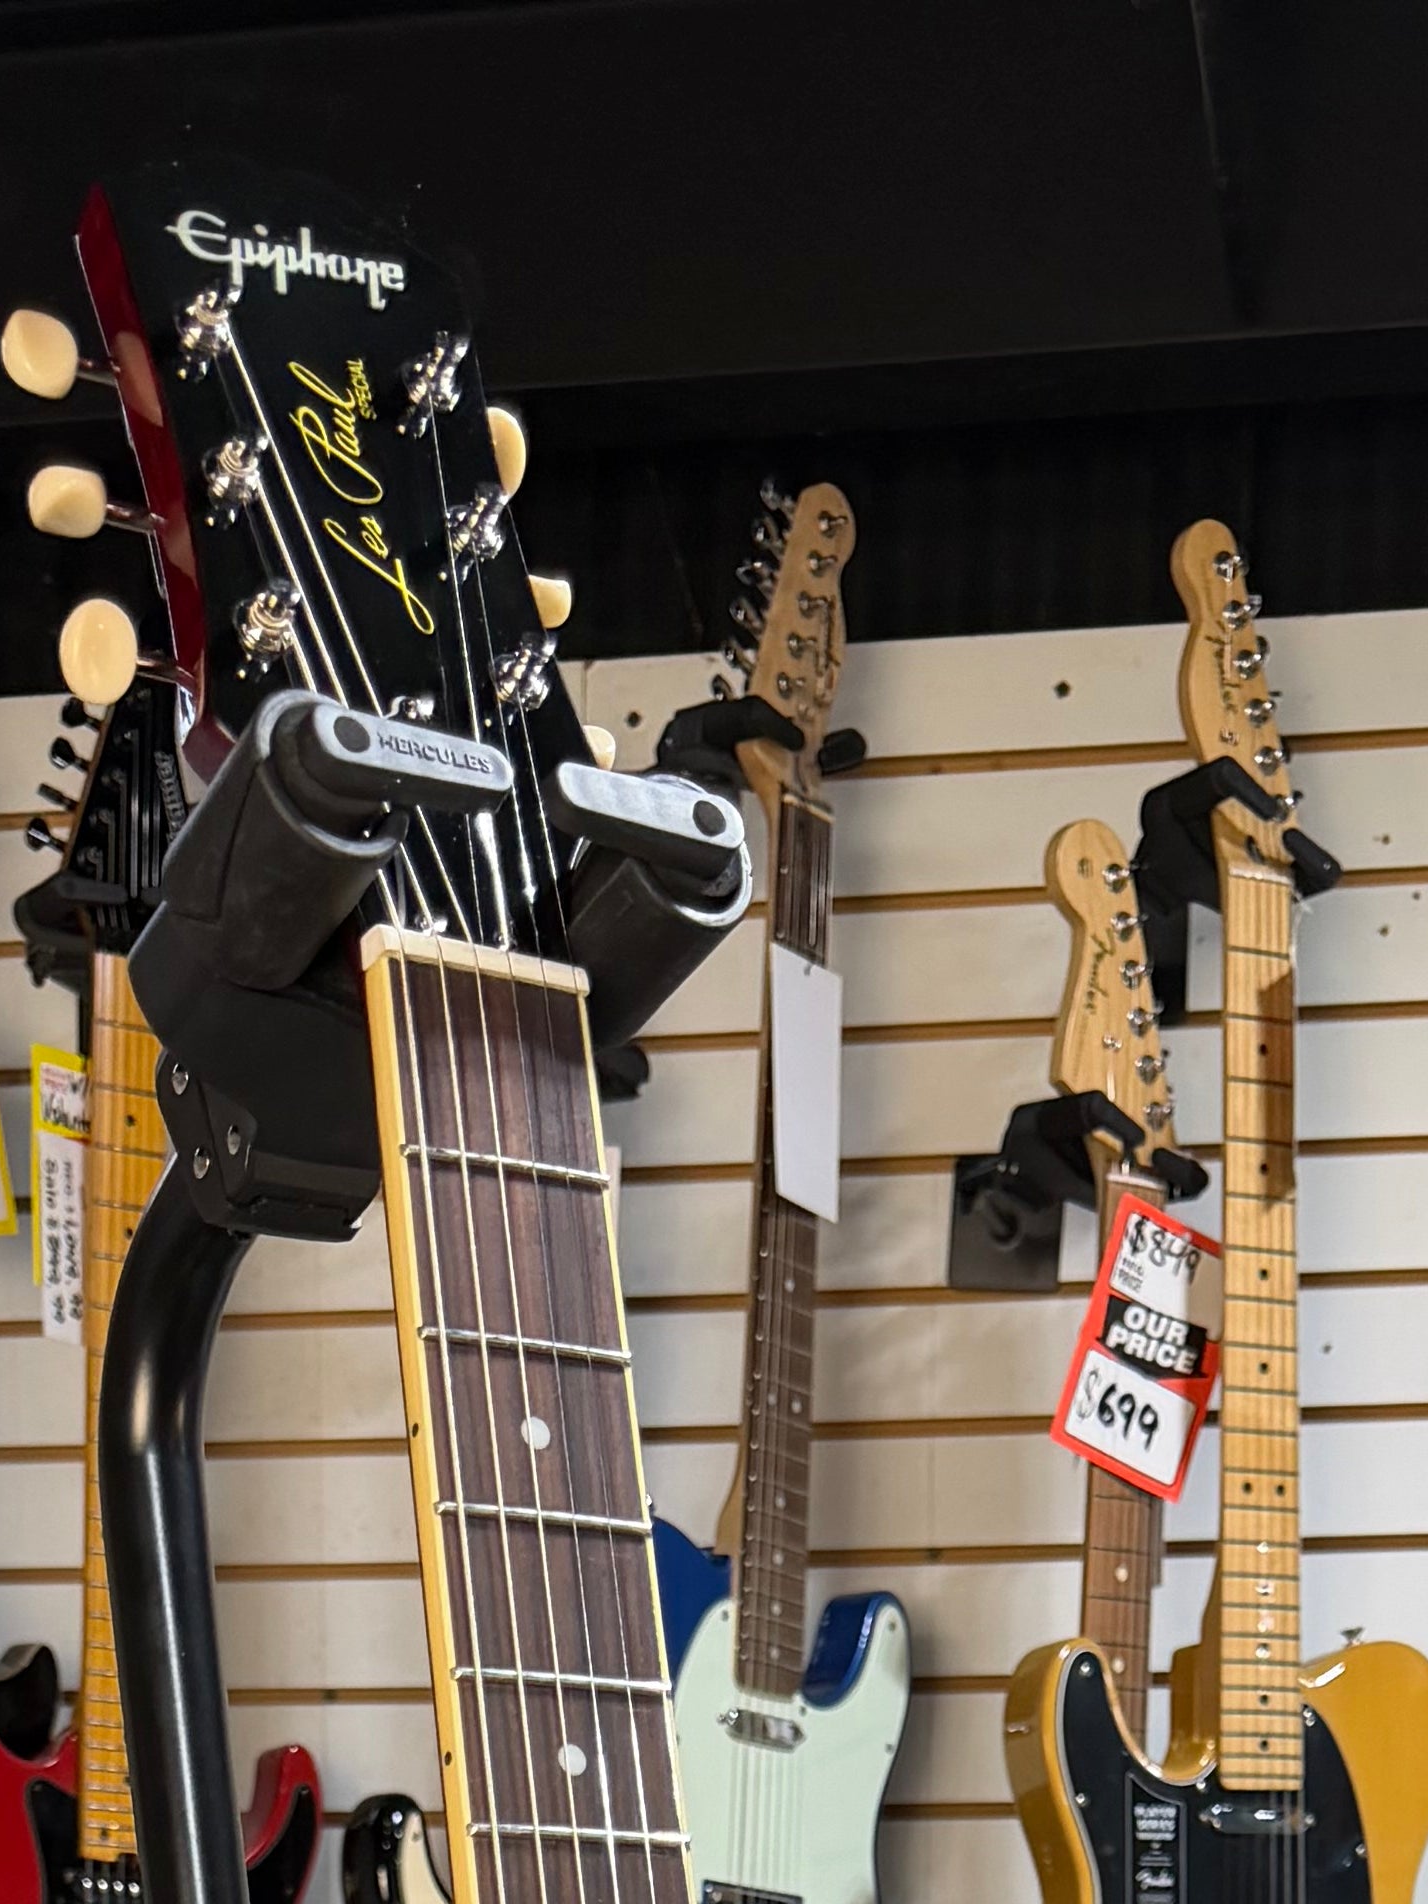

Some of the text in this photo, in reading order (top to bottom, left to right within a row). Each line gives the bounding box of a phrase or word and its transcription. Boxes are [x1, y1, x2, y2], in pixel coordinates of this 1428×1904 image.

[164, 209, 405, 310] Epiphone
[346, 357, 376, 422] SPECIAL
[288, 361, 434, 635] Les Paul
[376, 731, 493, 776] HERCULES
[1105, 1325, 1200, 1376] PRICE
[1124, 1303, 1190, 1347] OUR
[1076, 1368, 1160, 1452] $699
